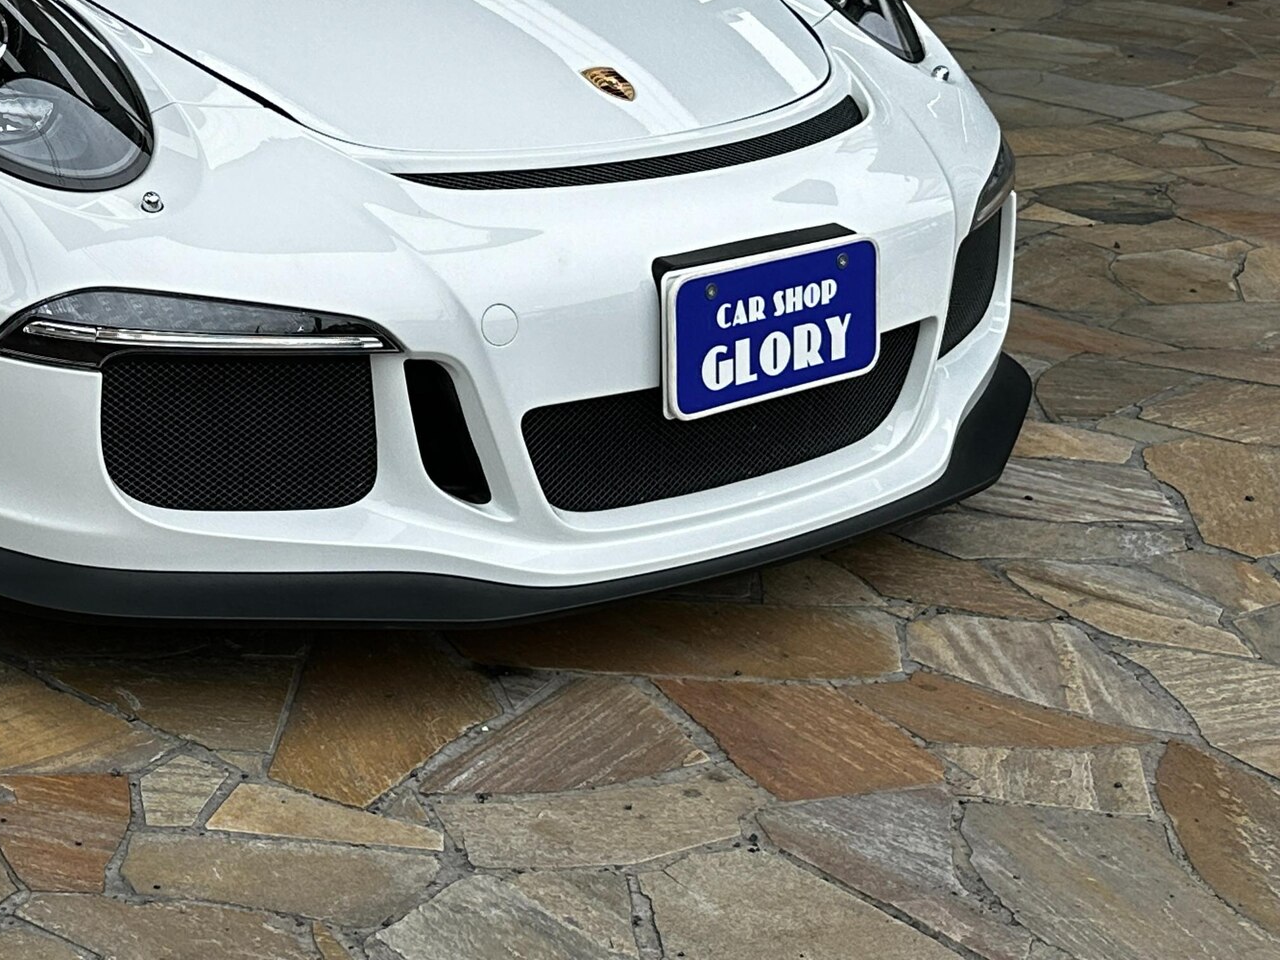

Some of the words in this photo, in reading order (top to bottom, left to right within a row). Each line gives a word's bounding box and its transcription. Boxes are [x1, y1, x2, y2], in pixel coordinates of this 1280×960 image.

[716, 295, 767, 329] CAR
[772, 278, 838, 317] SHOP
[701, 312, 852, 392] GLORY
